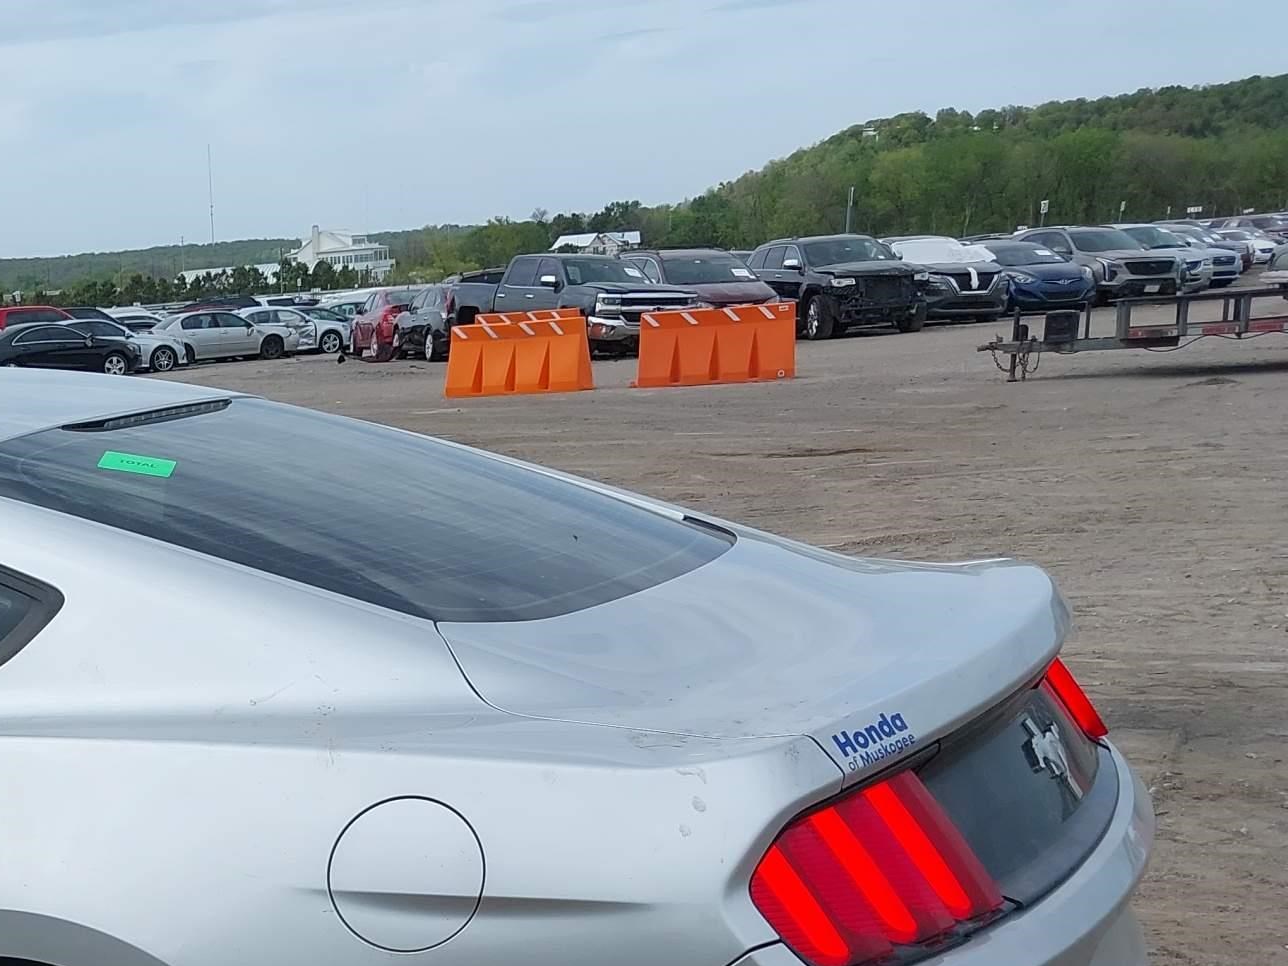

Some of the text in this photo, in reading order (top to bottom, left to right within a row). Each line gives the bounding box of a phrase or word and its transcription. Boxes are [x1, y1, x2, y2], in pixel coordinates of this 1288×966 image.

[119, 459, 159, 469] TOTAL
[831, 712, 909, 758] Honda
[848, 732, 916, 771] of Muskogee
